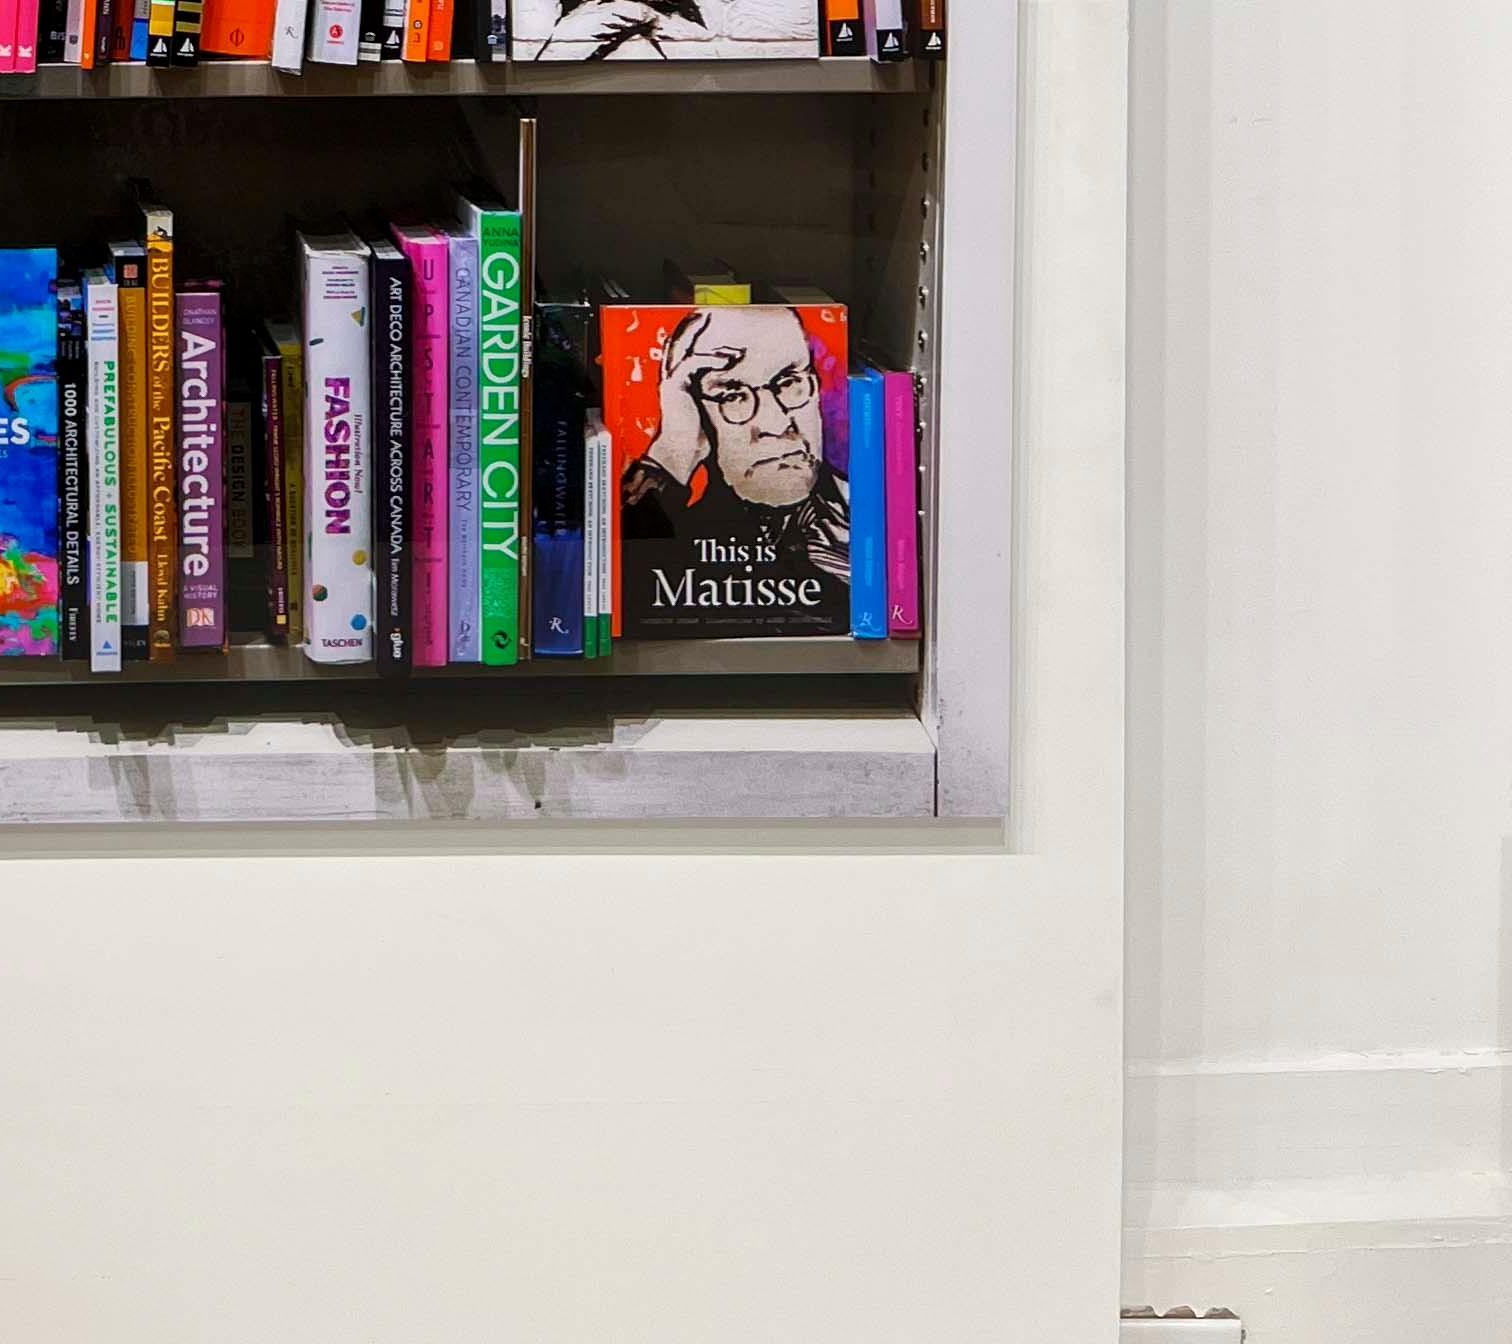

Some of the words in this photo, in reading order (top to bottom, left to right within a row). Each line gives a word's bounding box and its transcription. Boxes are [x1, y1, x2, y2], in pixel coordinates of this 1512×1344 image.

[481, 251, 520, 446] GARDEN
[182, 331, 217, 577] Architecture
[324, 377, 351, 535] FASHION
[481, 462, 518, 560] CITY
[652, 565, 821, 607] Matisse
[694, 539, 749, 563] This
[756, 535, 776, 562] is
